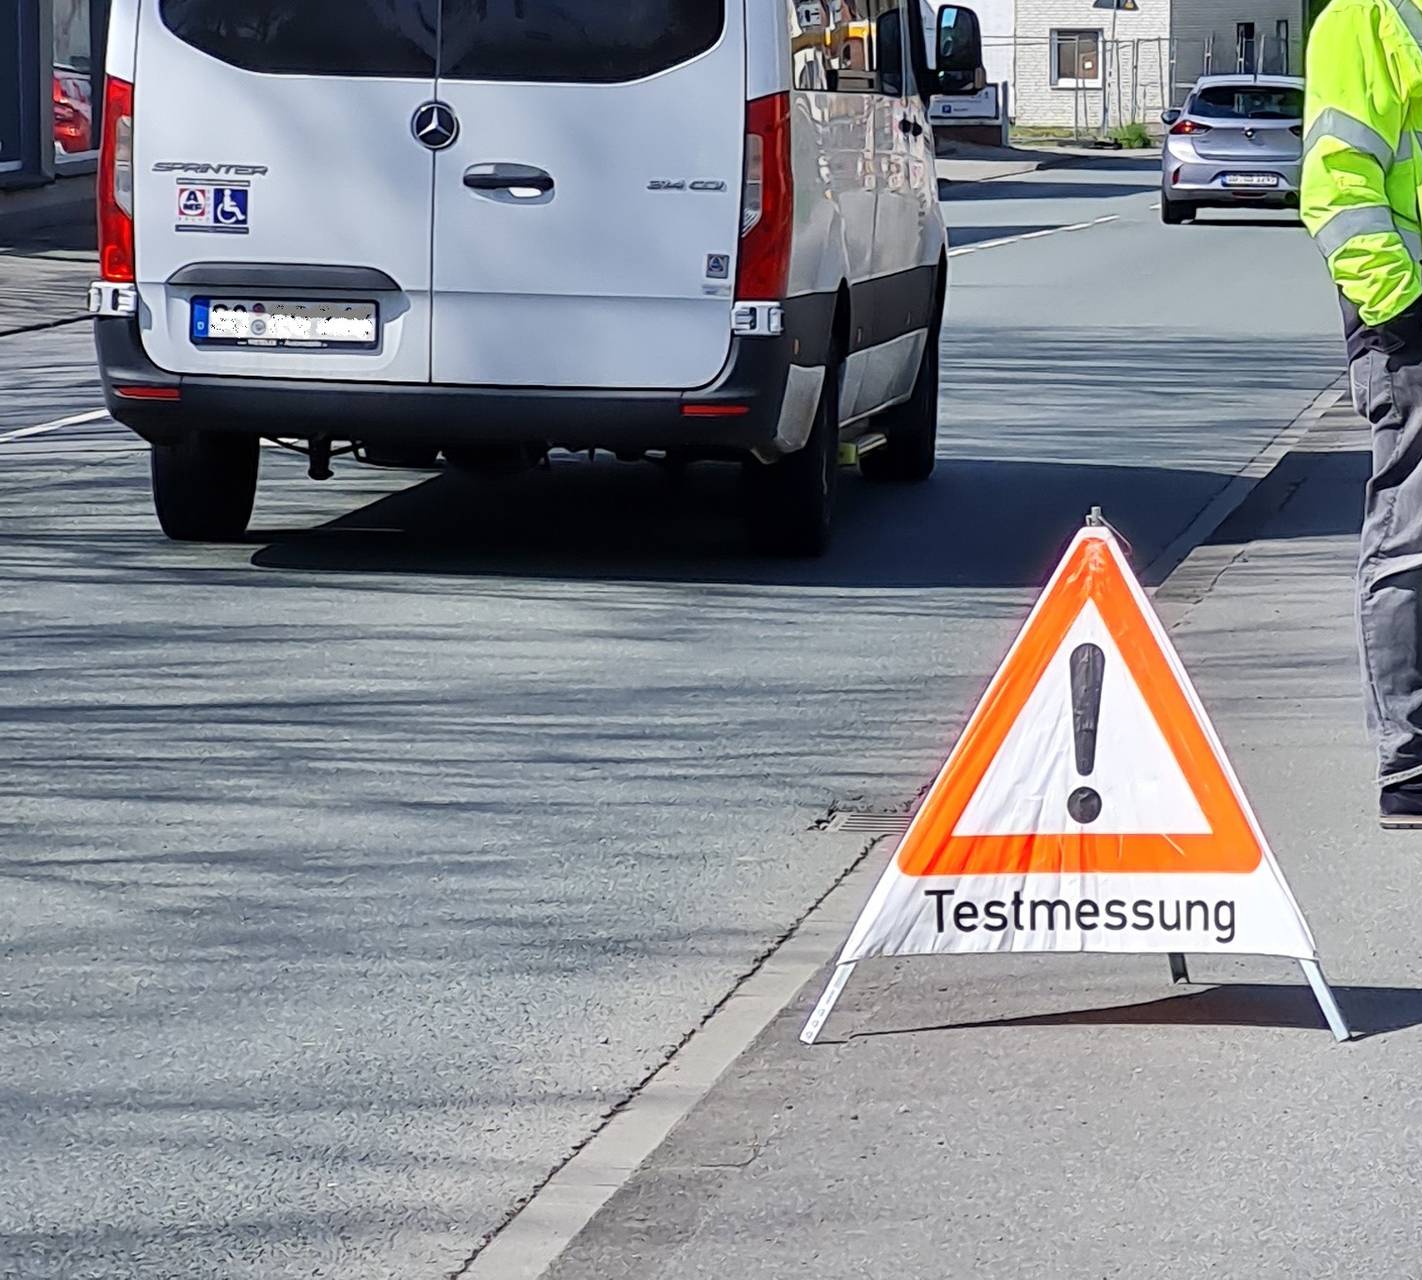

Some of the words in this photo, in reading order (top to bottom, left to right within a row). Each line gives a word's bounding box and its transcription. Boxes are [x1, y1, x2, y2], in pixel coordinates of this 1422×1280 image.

[151, 162, 269, 176] SPRINTER
[689, 180, 727, 192] CDI
[923, 888, 1236, 944] Testmessung
